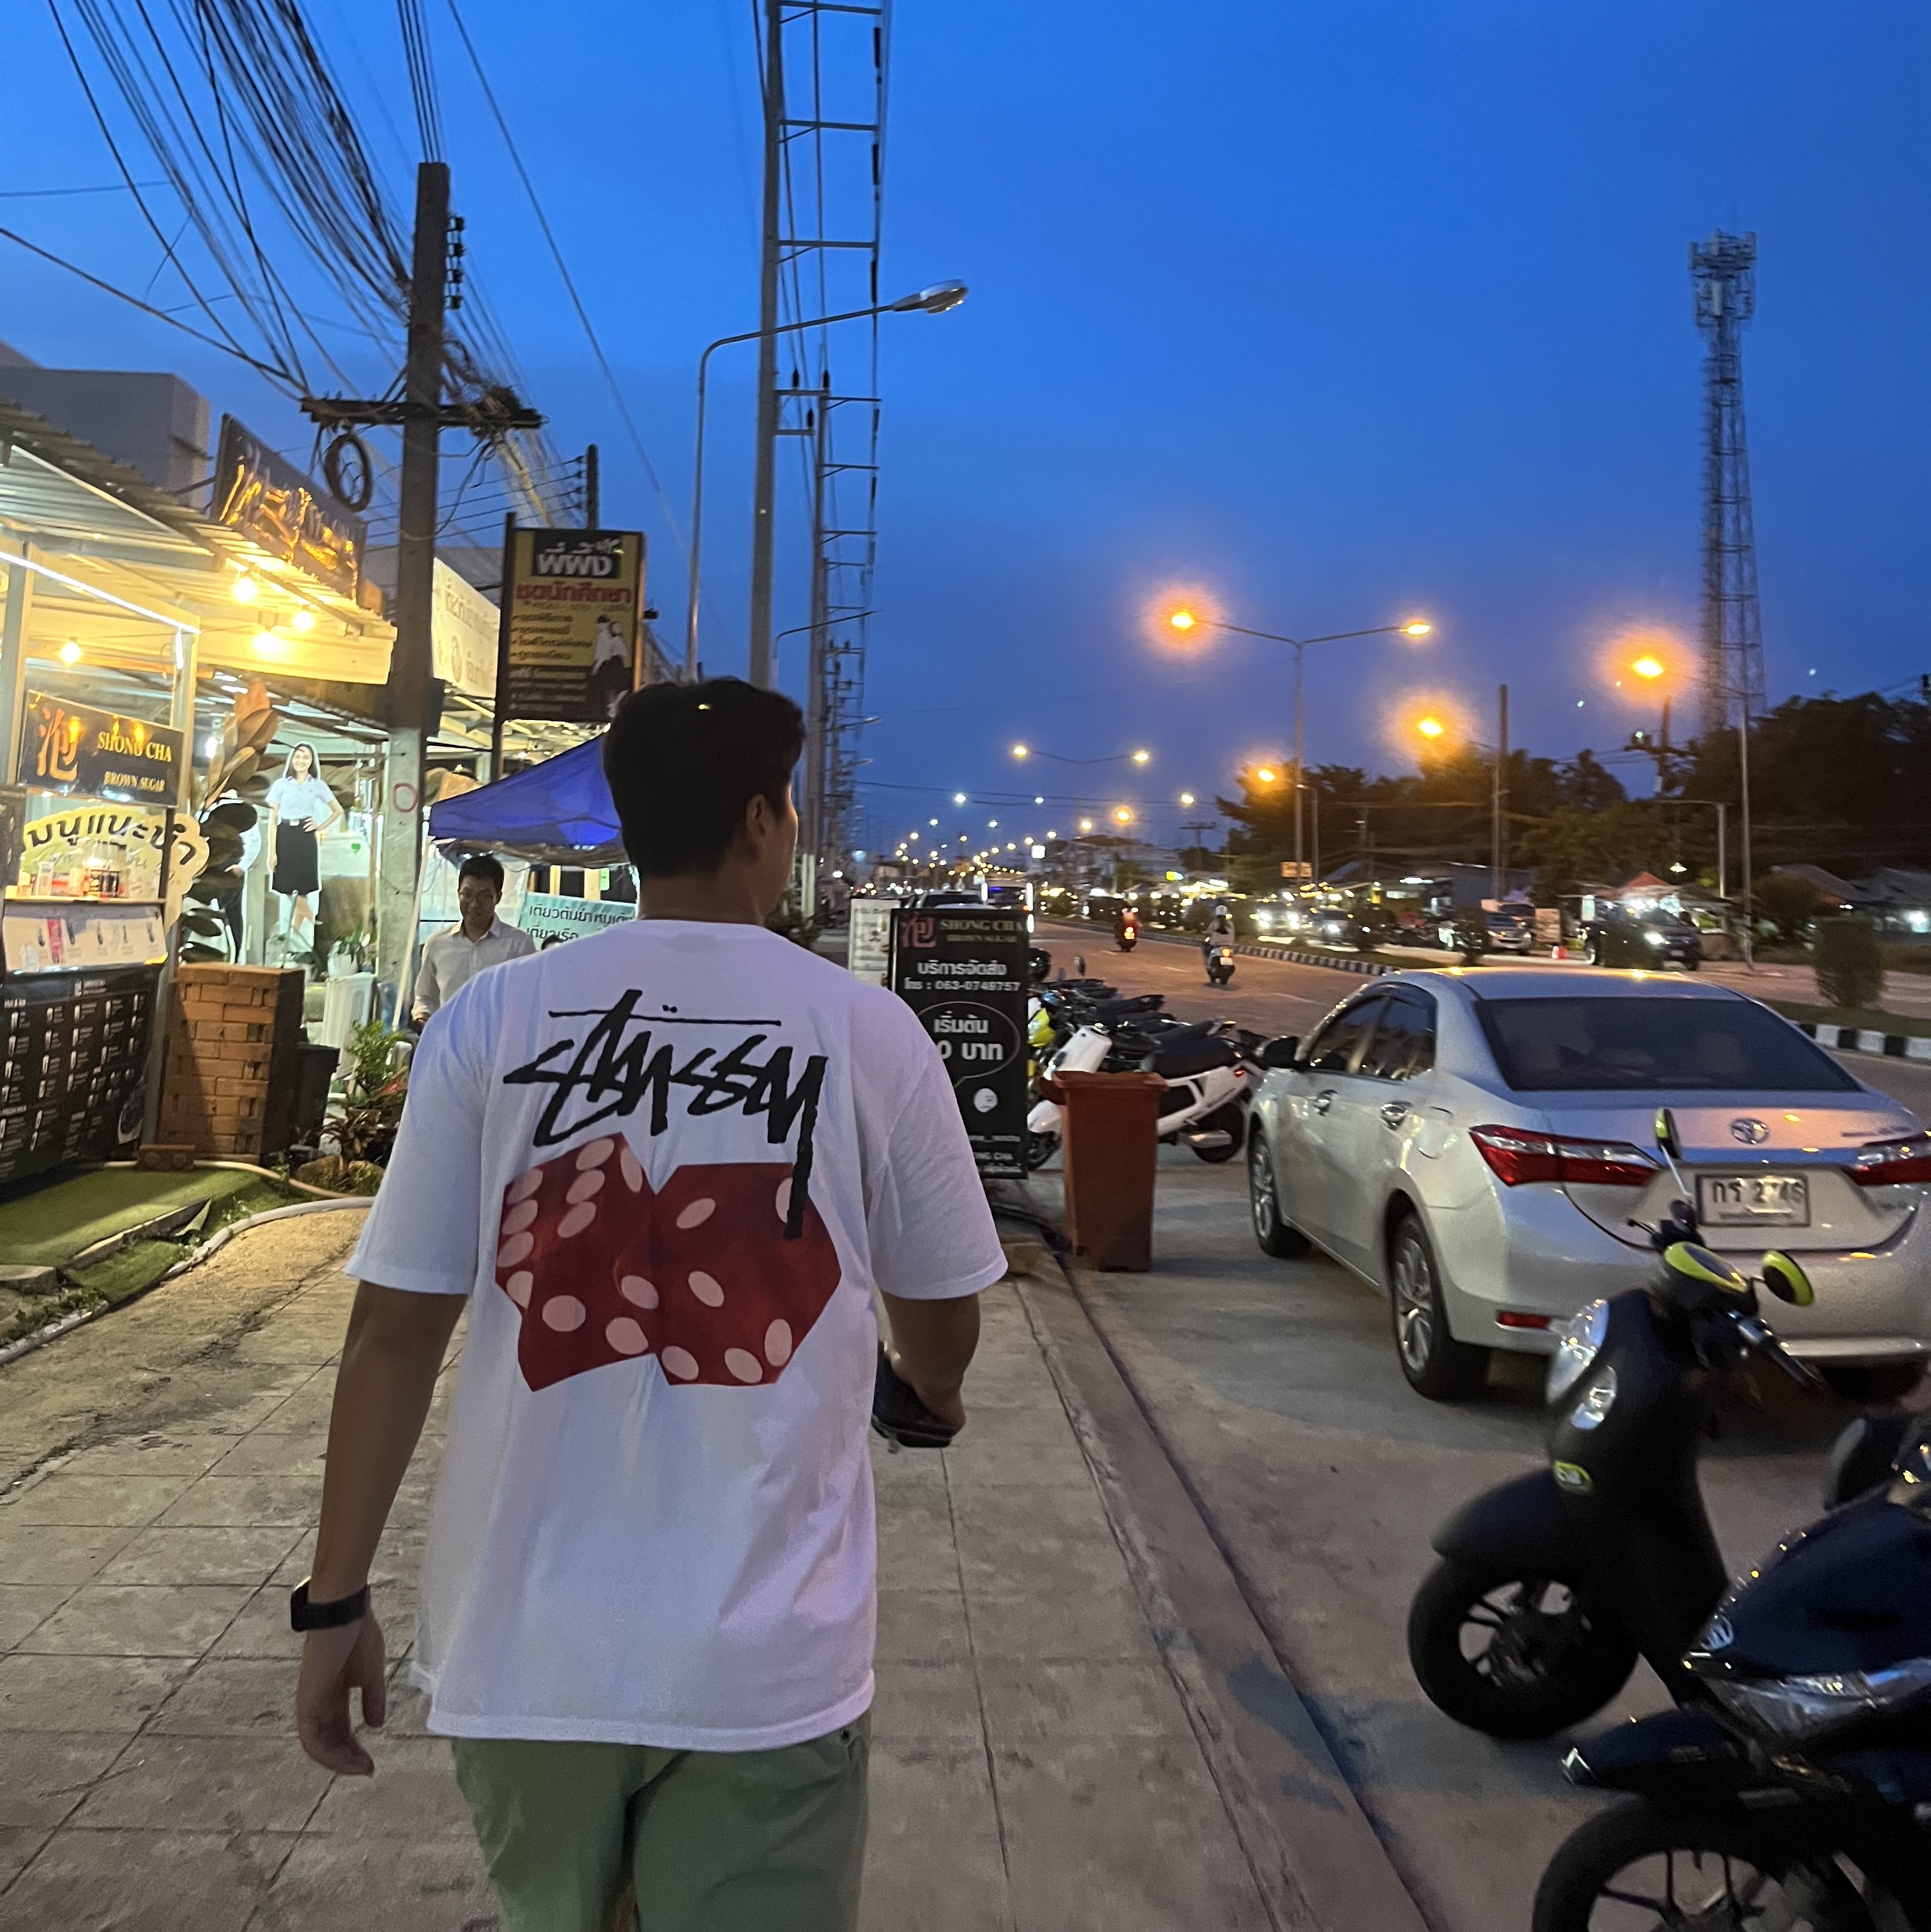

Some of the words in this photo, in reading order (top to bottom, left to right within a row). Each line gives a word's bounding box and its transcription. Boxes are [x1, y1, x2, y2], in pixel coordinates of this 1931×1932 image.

[98, 731, 144, 757] SHONG
[146, 741, 172, 762] CHA
[103, 771, 137, 788] BROWN
[934, 1010, 989, 1034] เริ่มต้น
[961, 1042, 1004, 1061] บาท
